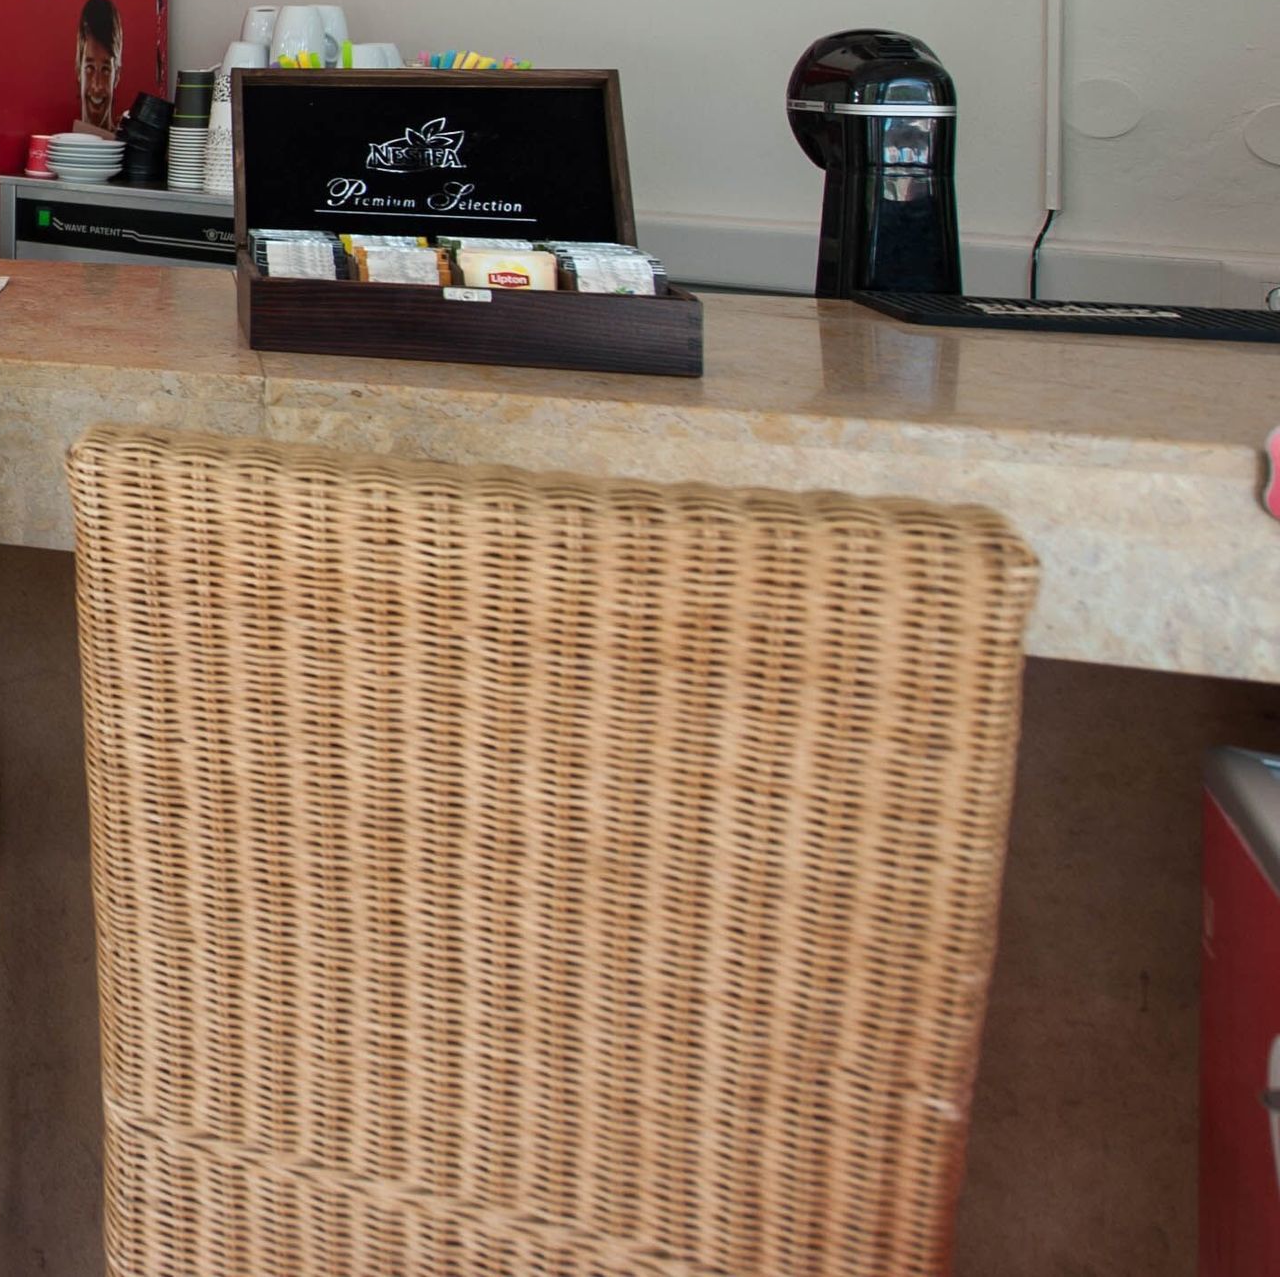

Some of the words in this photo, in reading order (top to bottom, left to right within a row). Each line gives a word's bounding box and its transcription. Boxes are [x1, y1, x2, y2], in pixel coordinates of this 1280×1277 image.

[327, 177, 416, 207] Premium
[427, 181, 522, 213] Selection
[64, 223, 87, 233] WAVE
[90, 225, 121, 237] PATENT
[490, 274, 528, 285] Lipton
